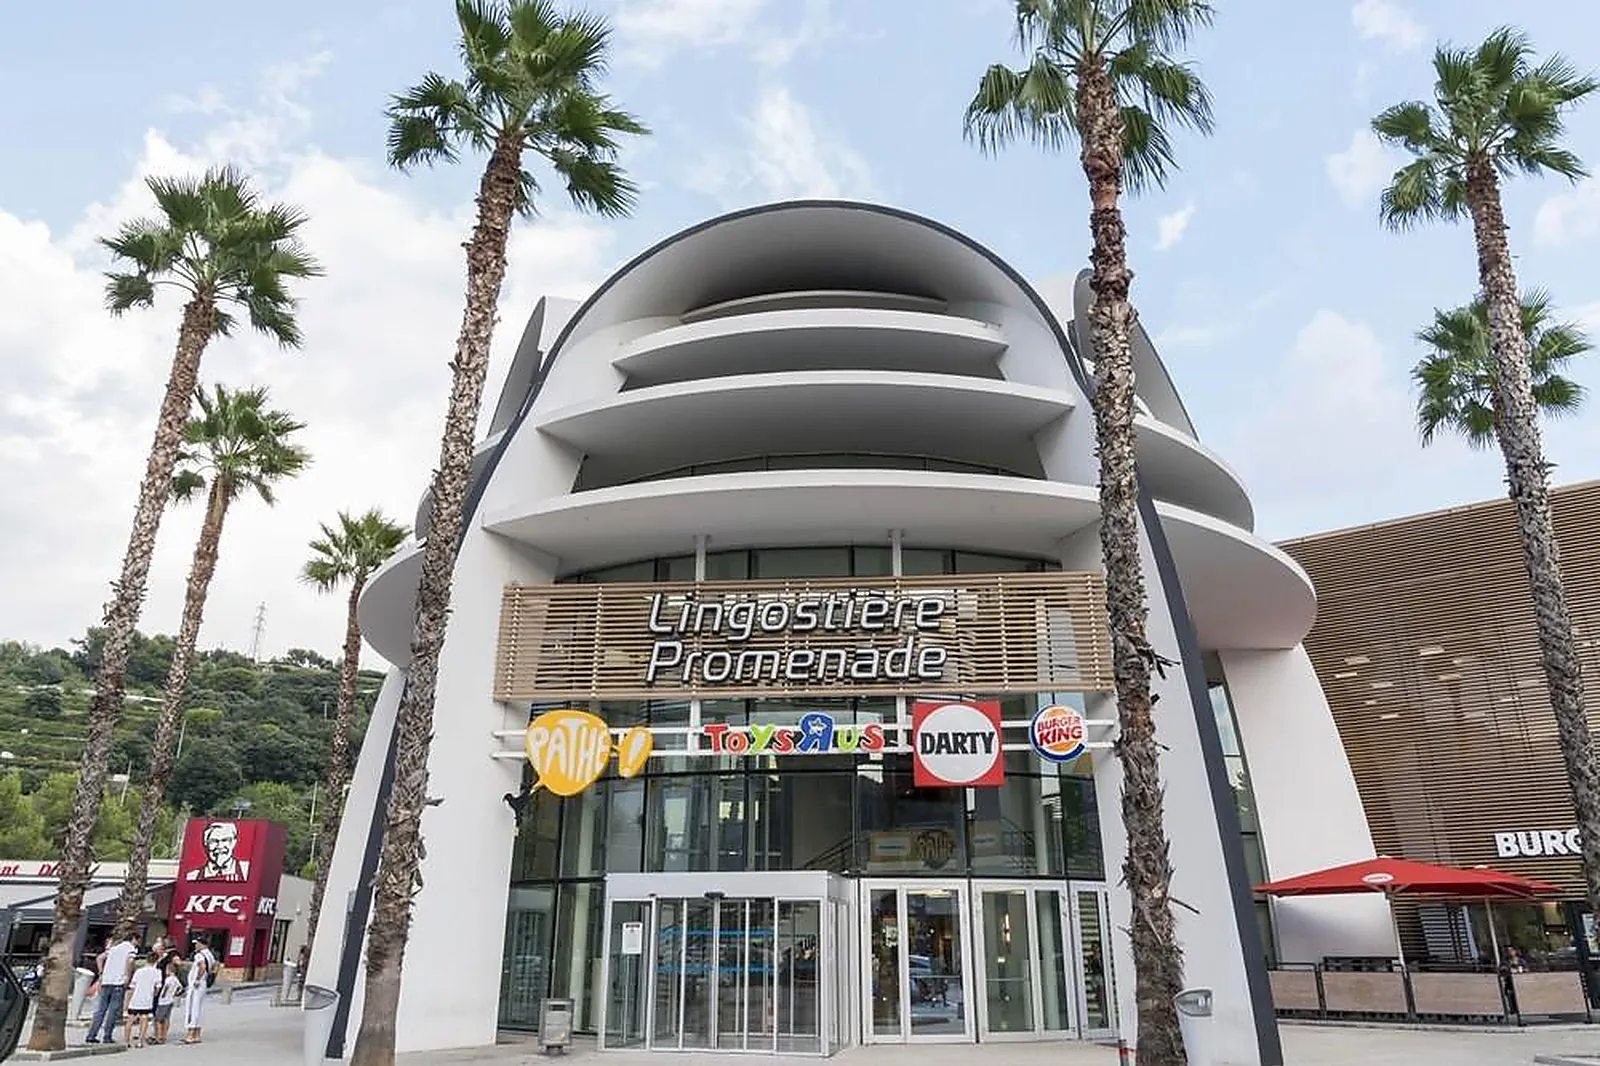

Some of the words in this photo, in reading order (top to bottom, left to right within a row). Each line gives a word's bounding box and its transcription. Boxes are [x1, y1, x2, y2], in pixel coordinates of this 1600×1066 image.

[649, 589, 946, 641] Lingostière
[646, 635, 947, 682] Promenade
[1036, 715, 1082, 734] BURGER
[920, 731, 996, 756] DARTY
[1038, 726, 1084, 747] KING
[183, 894, 243, 914] KFC
